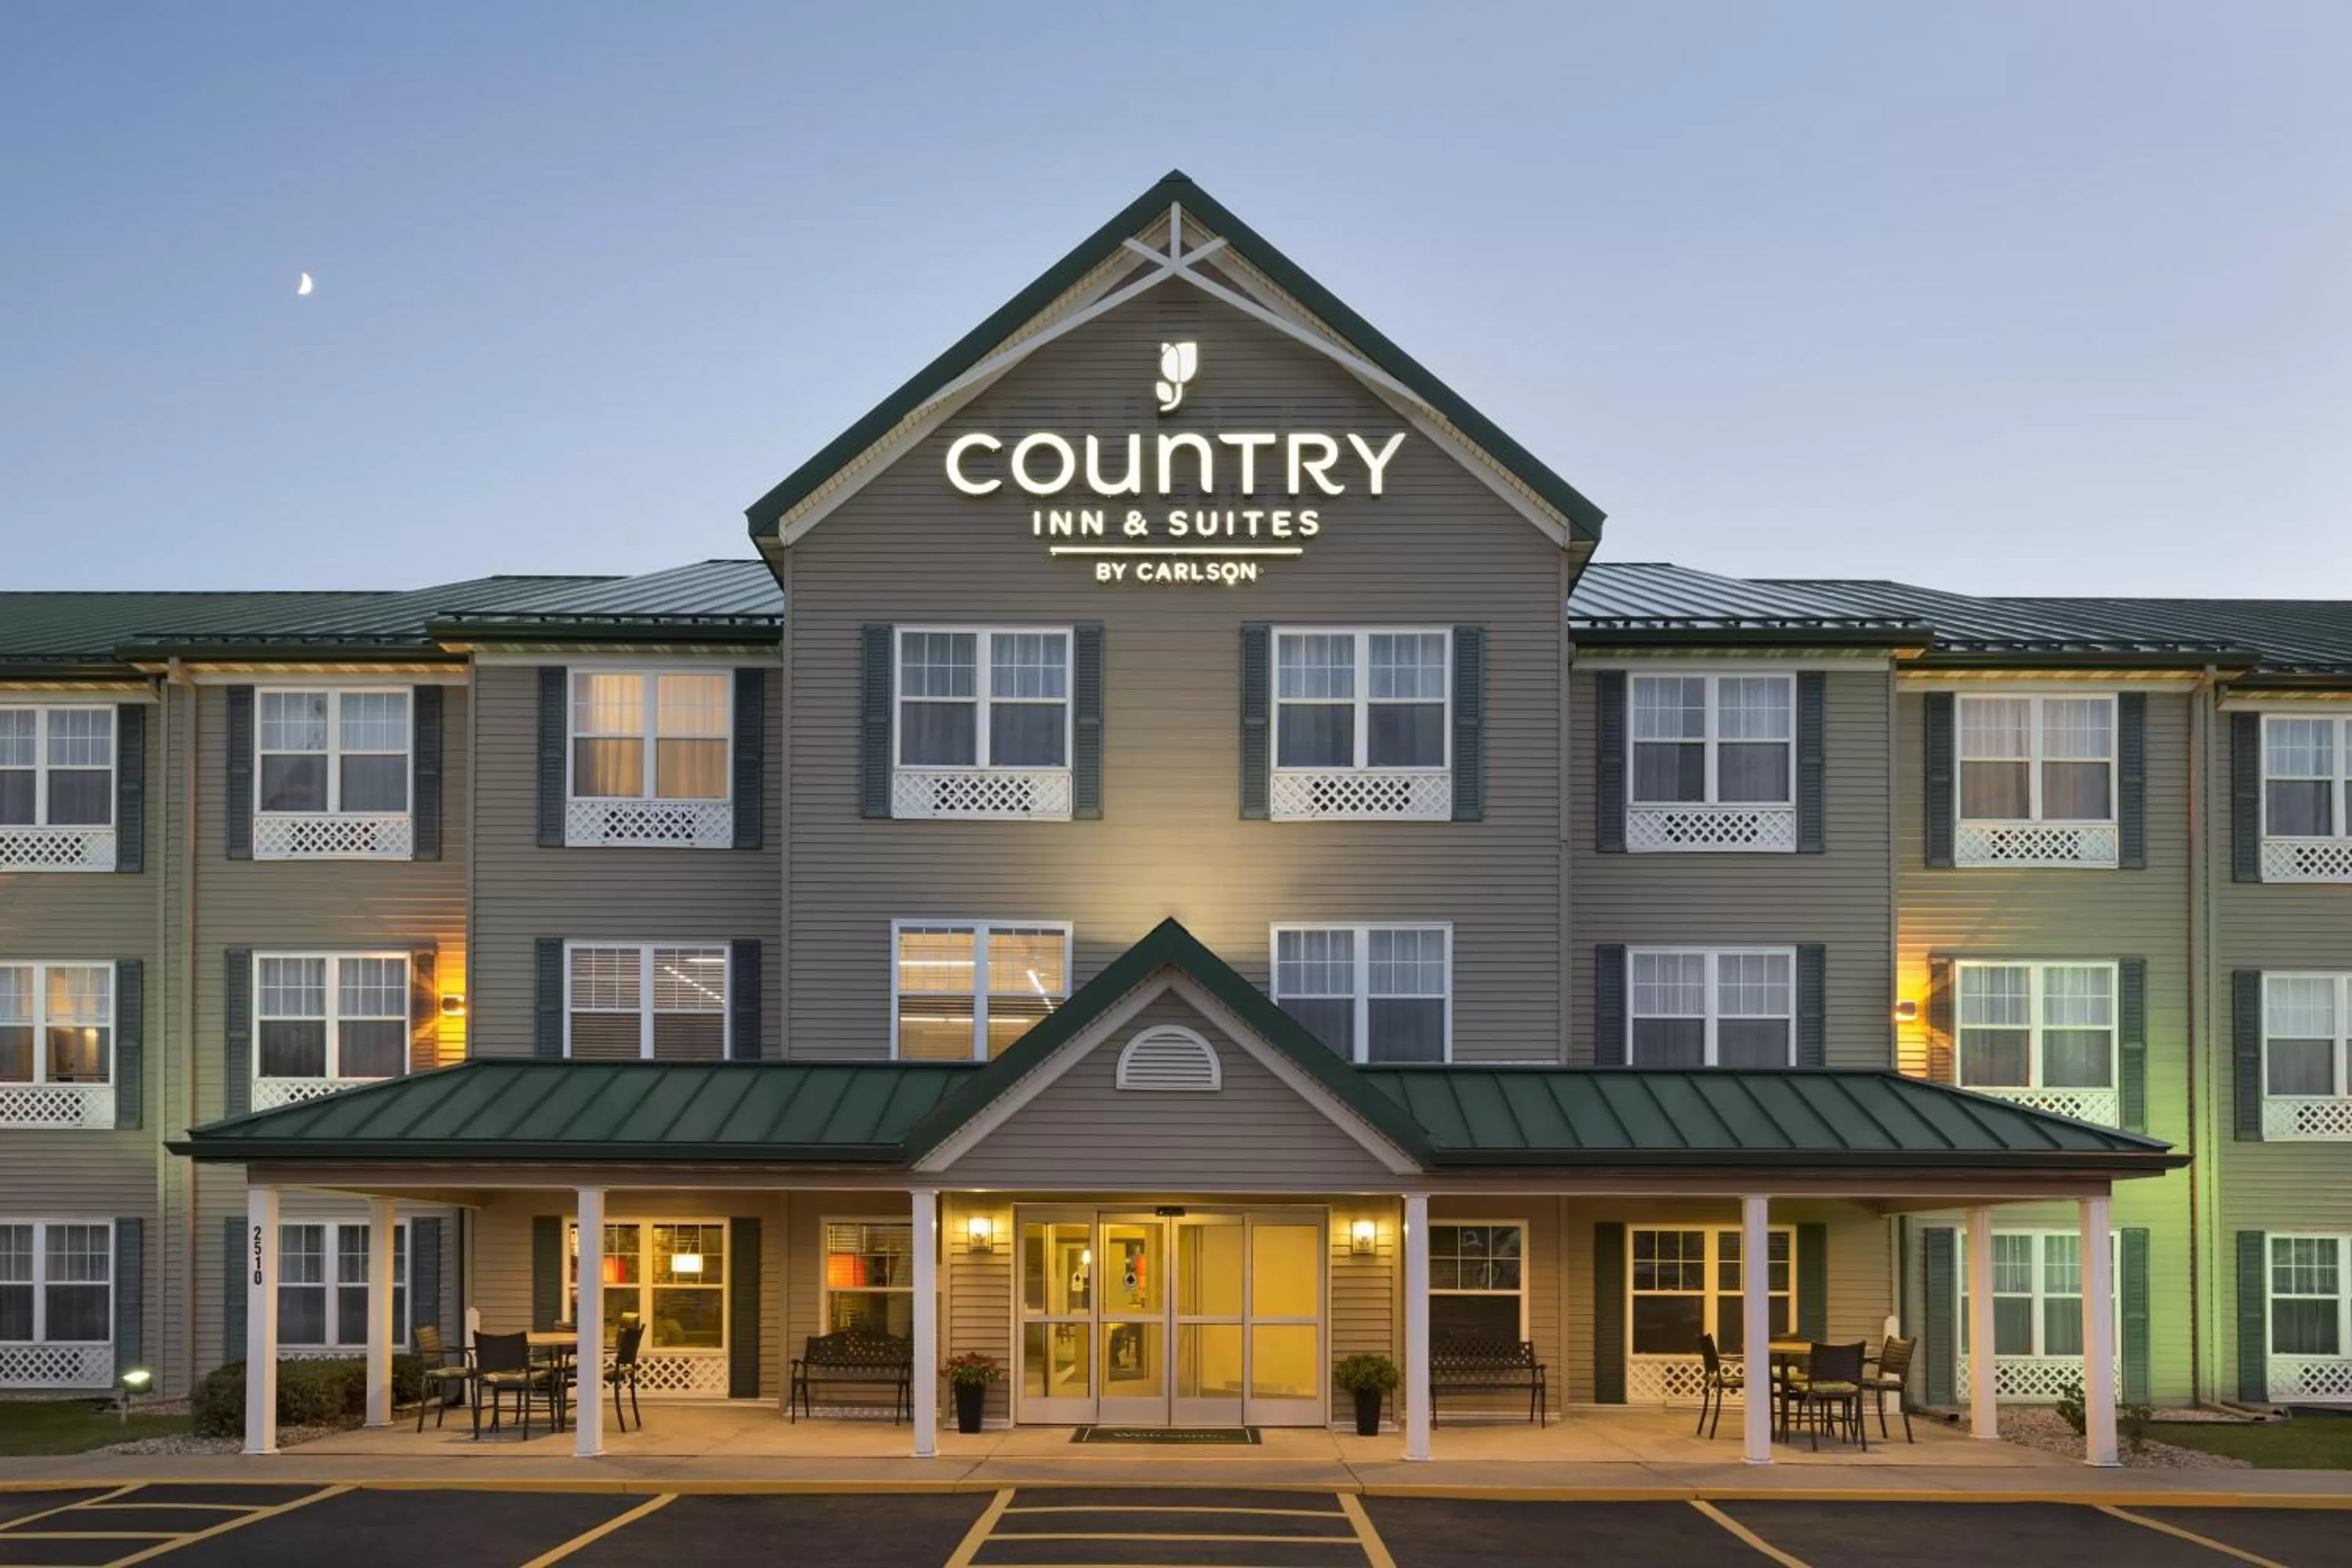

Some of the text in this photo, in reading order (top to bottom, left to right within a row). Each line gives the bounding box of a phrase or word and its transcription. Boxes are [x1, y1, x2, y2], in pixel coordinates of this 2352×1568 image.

[1033, 510, 1319, 536] INN & SUITES
[1096, 562, 1256, 584] BY CARLSON
[253, 1225, 263, 1286] 2510
